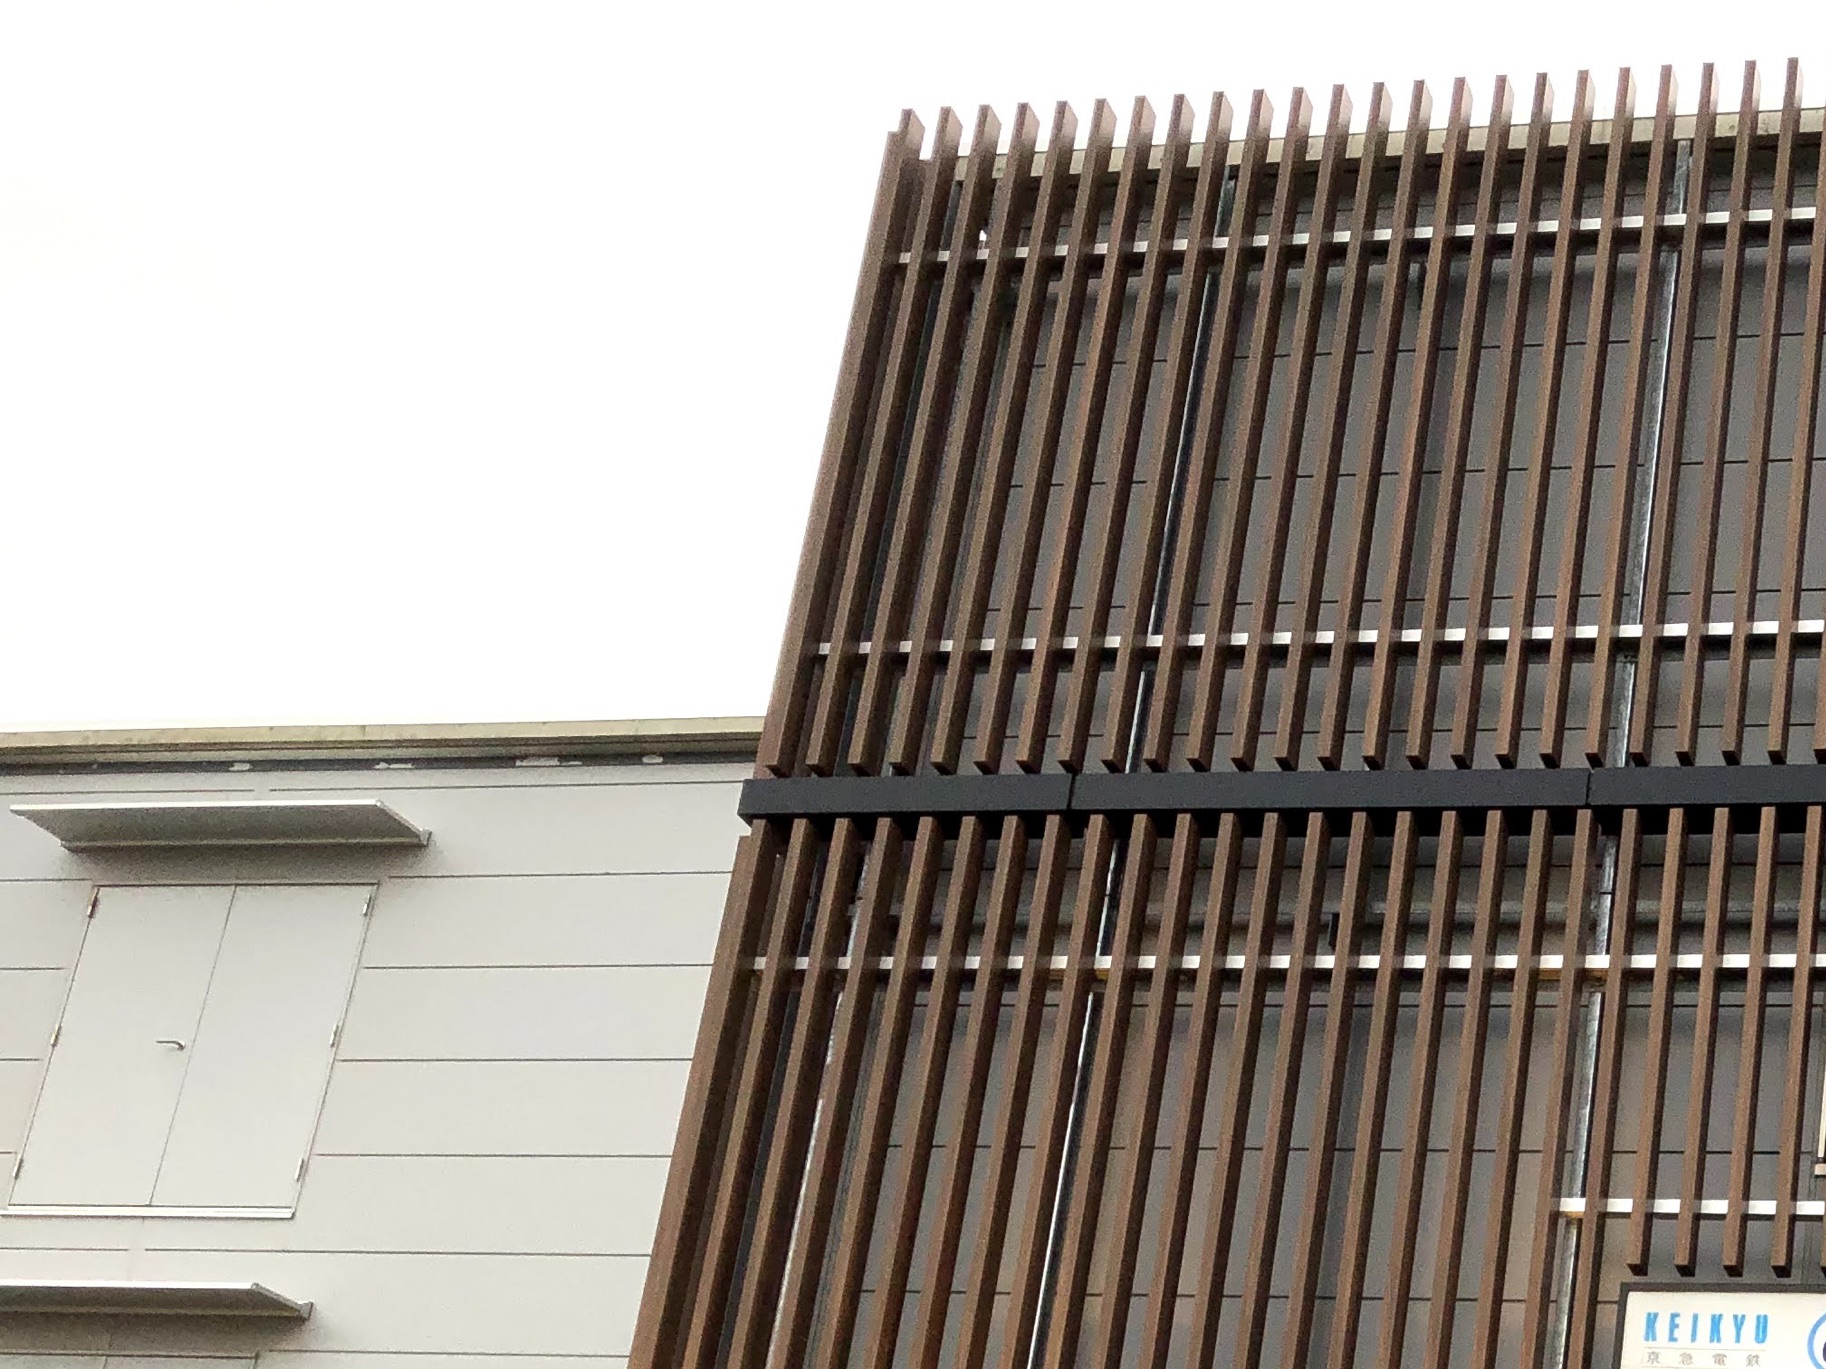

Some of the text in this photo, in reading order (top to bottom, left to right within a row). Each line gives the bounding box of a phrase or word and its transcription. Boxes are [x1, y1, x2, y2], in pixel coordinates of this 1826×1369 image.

[1643, 1311, 1769, 1344] KEIKYU
[1646, 1350, 1761, 1367] 京急電鉄
